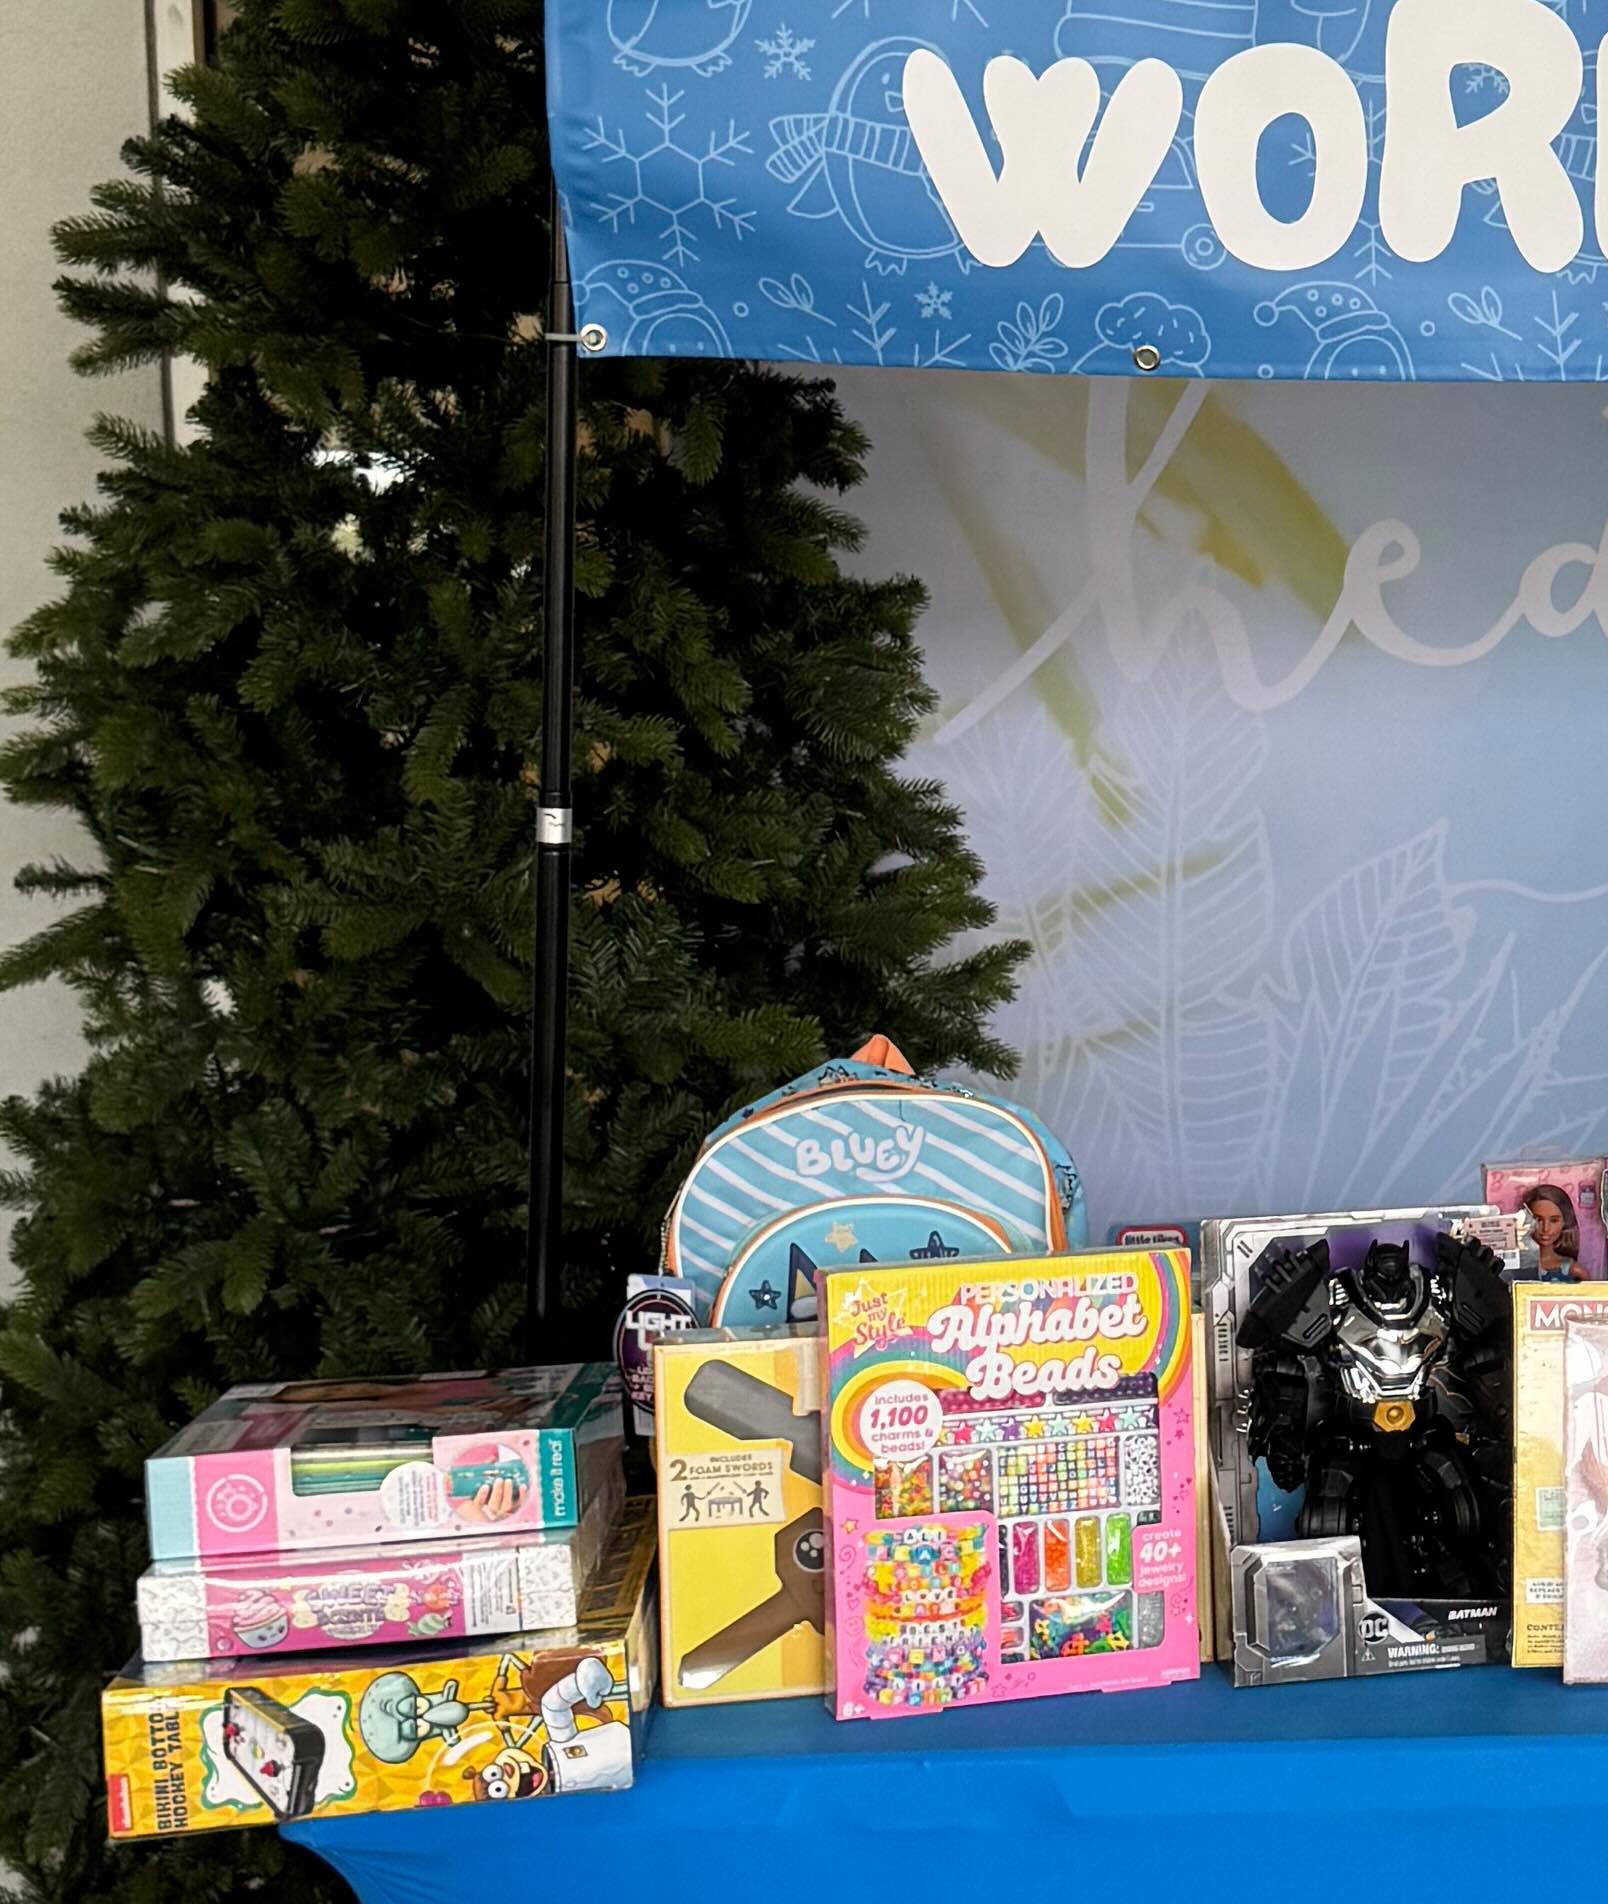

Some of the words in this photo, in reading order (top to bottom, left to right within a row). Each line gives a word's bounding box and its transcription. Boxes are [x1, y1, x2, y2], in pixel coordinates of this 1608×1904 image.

[797, 1126, 925, 1183] BLUEY
[961, 1271, 1138, 1304] PERSONALIZED
[851, 1292, 889, 1316] Just
[854, 1312, 907, 1350] Style
[927, 1292, 1148, 1353] Alphabet
[965, 1345, 1121, 1400] Beads
[874, 1392, 930, 1406] includes
[869, 1405, 929, 1429] 1,100
[871, 1428, 922, 1443] charms
[925, 1428, 934, 1438] &
[880, 1440, 926, 1454] beads!
[548, 1439, 562, 1467] real
[669, 1458, 688, 1482] 2
[690, 1465, 722, 1475] FOAM
[725, 1462, 774, 1473] SWORDS
[552, 1477, 567, 1517] make
[1142, 1528, 1182, 1542] create
[1139, 1541, 1182, 1564] 40+
[1137, 1572, 1187, 1589] designs!
[1138, 1561, 1185, 1577] jewelry
[1448, 1606, 1498, 1621] BATMAN
[1360, 1618, 1389, 1639] DC
[1388, 1645, 1440, 1659] WARNING:
[149, 1701, 168, 1771] BOTTO
[164, 1702, 183, 1754] TABL
[153, 1779, 172, 1831] BIKINI
[169, 1761, 189, 1829] HOCKEY
